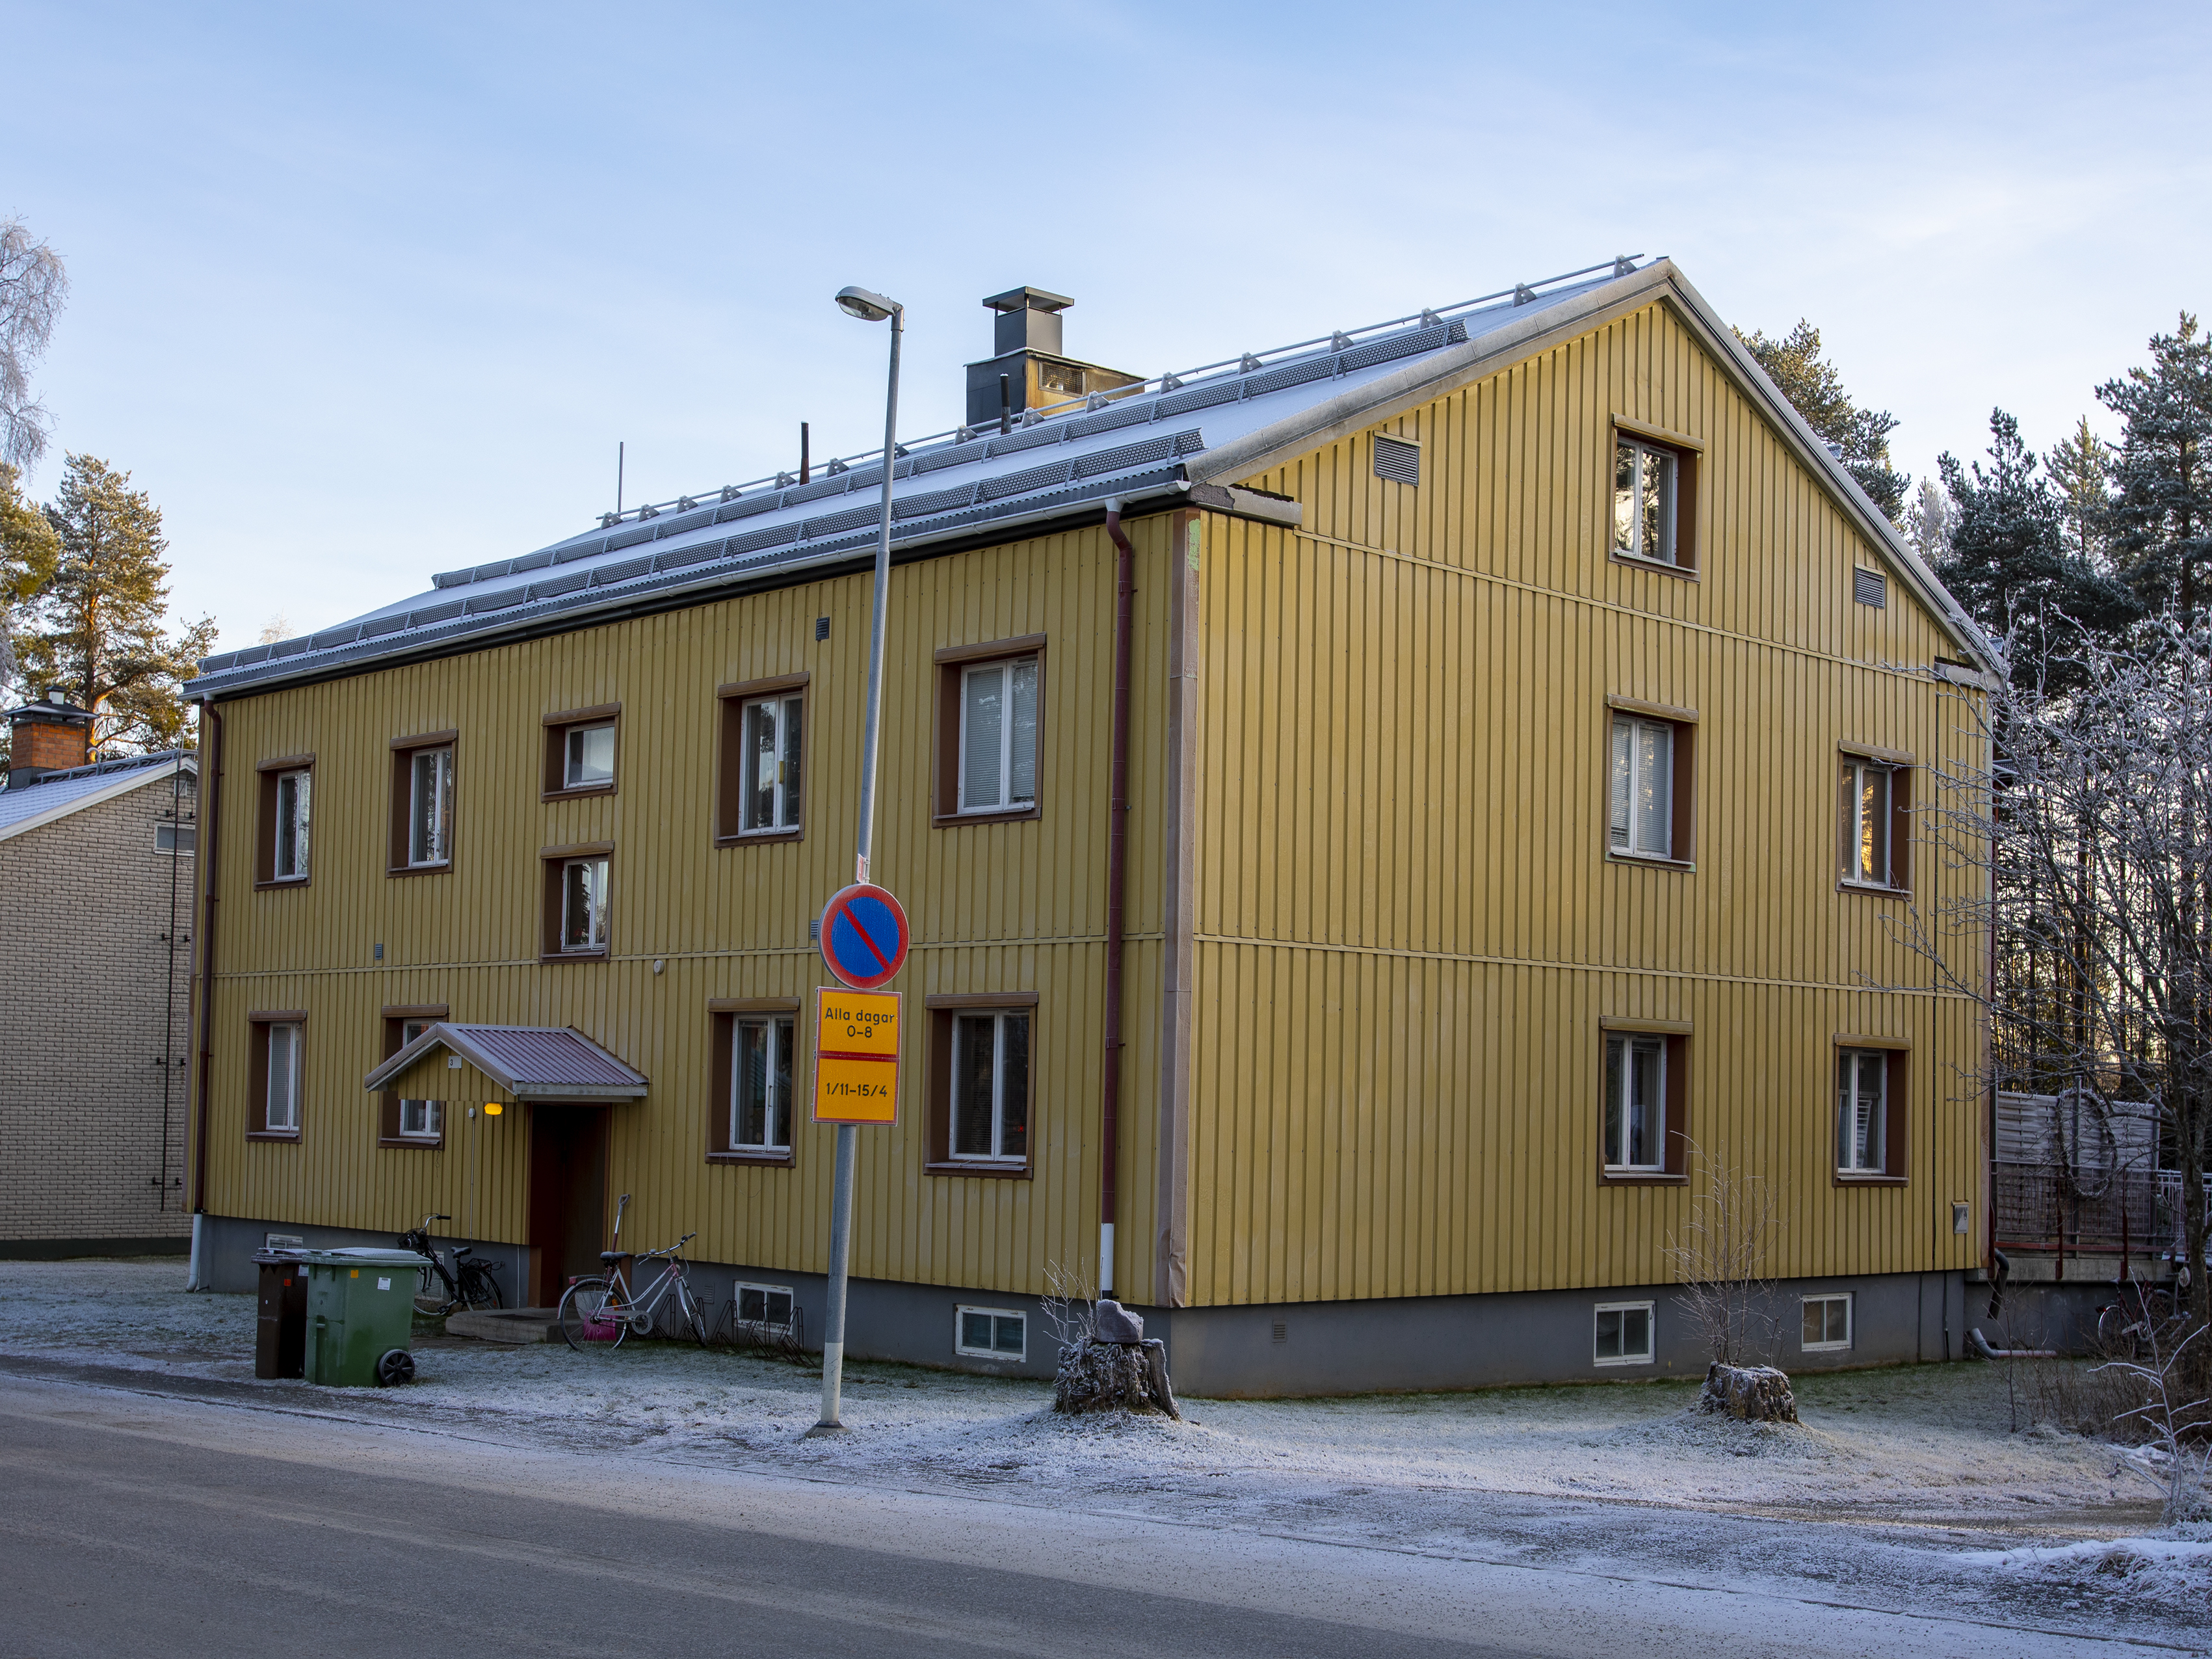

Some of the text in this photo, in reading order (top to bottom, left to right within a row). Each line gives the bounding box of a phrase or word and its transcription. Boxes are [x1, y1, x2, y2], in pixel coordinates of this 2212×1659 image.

[825, 1007, 895, 1026] Alla dagar
[847, 1025, 873, 1039] 0-8
[826, 1082, 888, 1098] 1/11-15/4
